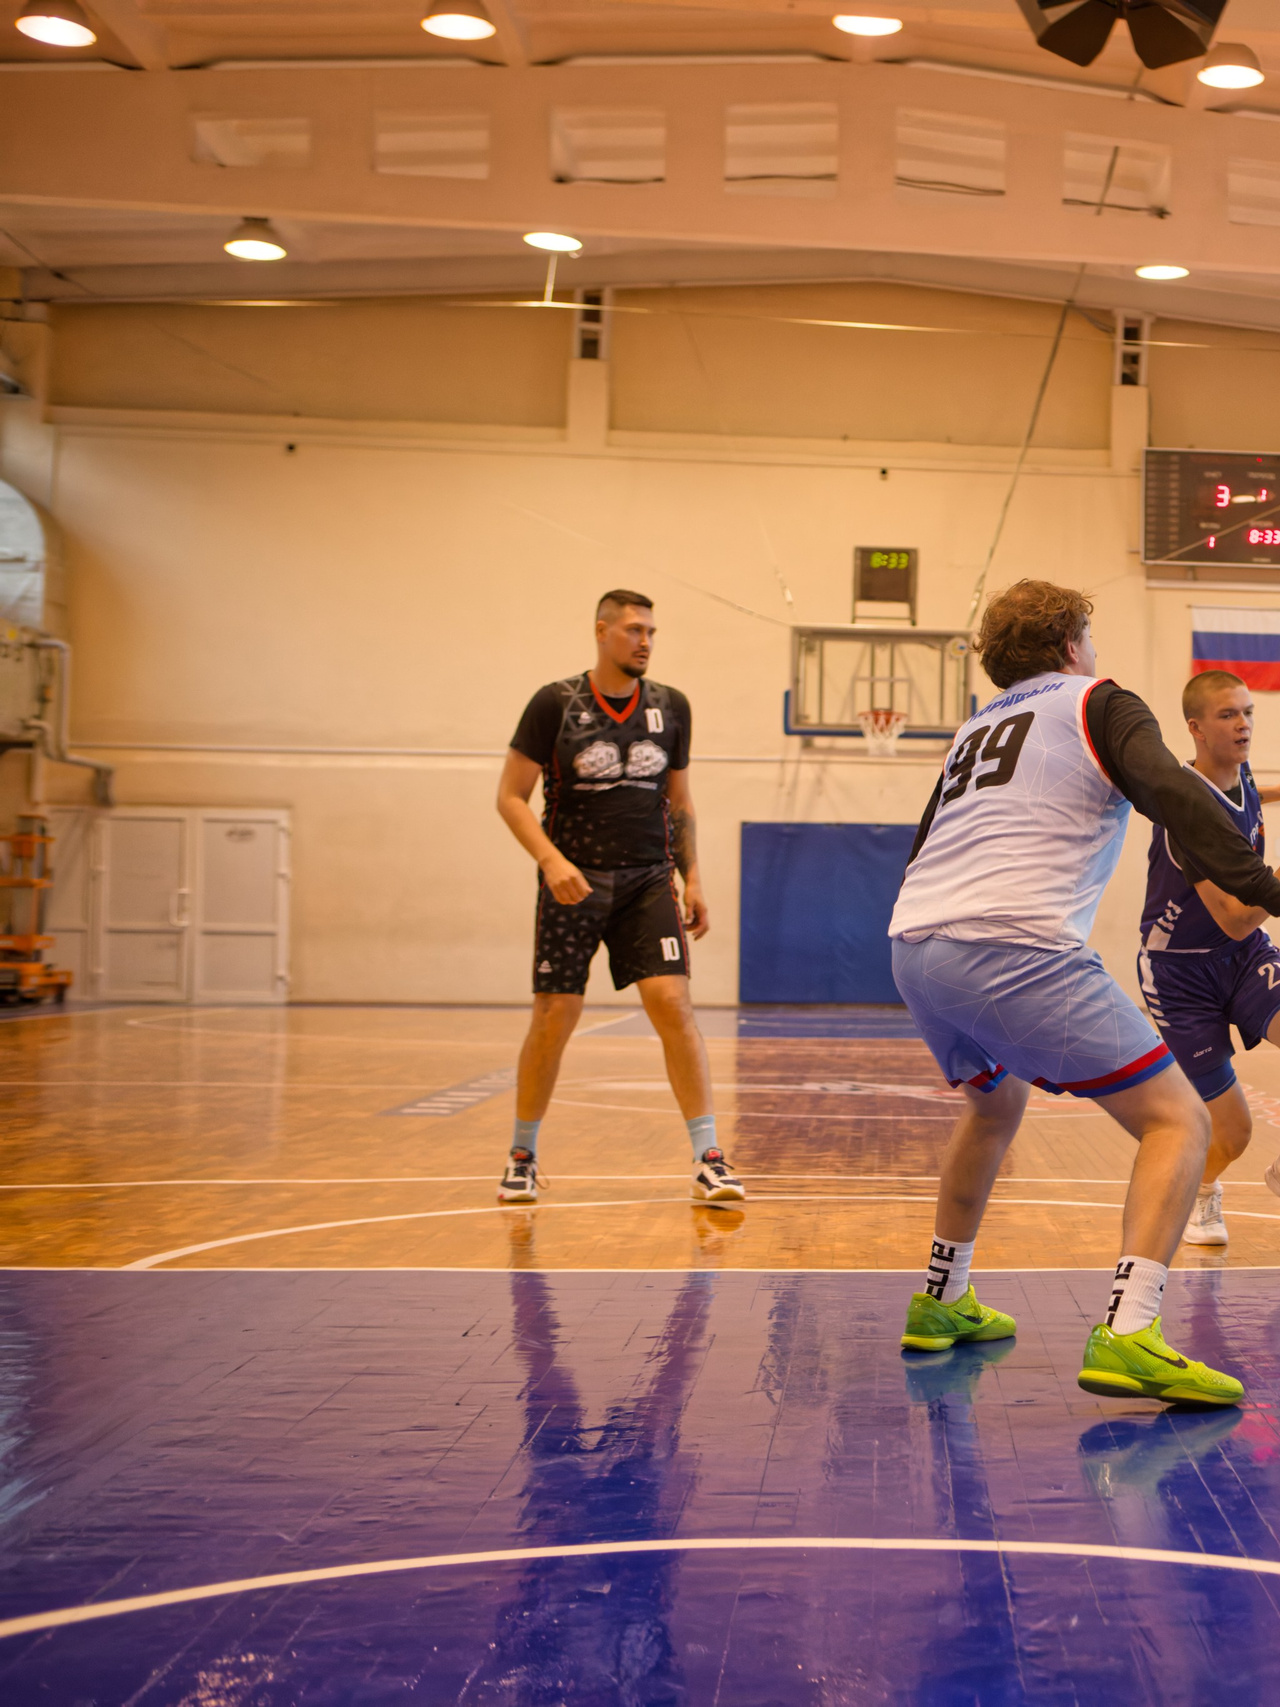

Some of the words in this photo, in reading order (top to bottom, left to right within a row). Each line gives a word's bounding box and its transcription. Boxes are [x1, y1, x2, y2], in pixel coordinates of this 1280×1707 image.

[1215, 484, 1230, 507] 3
[645, 708, 664, 733] 10
[941, 710, 1036, 807] 99
[660, 937, 681, 961] 10
